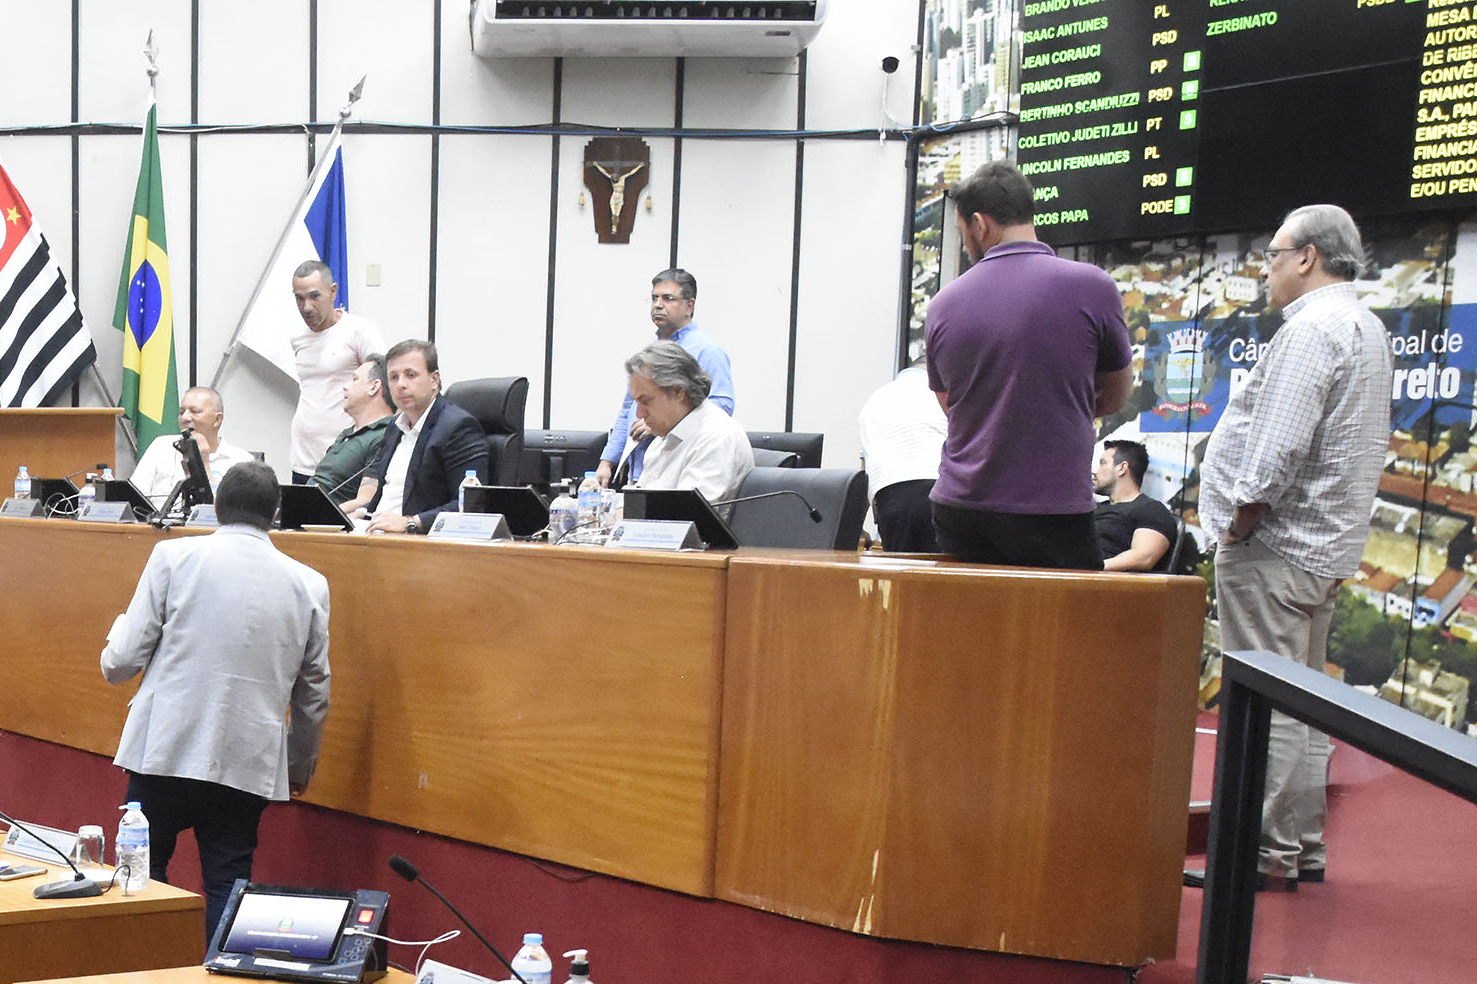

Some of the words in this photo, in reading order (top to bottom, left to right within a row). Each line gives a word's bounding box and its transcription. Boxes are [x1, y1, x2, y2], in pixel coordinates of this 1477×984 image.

[1024, 27, 1055, 44] ISAAC
[1056, 16, 1109, 38] ANTUNES
[1154, 5, 1170, 19] PL
[1206, 11, 1278, 37] ZERBINATO
[1426, 6, 1470, 28] MESA
[1022, 53, 1050, 70] JEAN
[1051, 44, 1102, 65] CORAUCI
[1152, 30, 1178, 47] PSD
[1422, 49, 1444, 67] DE
[1020, 77, 1064, 96] FRANCO
[1064, 70, 1102, 89] FERRO
[1150, 59, 1169, 75] PP
[1019, 102, 1074, 123] BERTINHO
[1075, 92, 1141, 115] SCANDIUZZI
[1148, 86, 1174, 103] PSD
[1417, 105, 1451, 124] S.A.,
[1018, 131, 1071, 150] COLETIVO
[1071, 124, 1111, 142] JUDETI
[1111, 120, 1139, 136] ZILLI
[1145, 116, 1163, 132] PT
[1063, 150, 1131, 171] FERNANDES
[1144, 146, 1161, 160] PL
[1142, 173, 1168, 188] PSD
[1410, 180, 1446, 198] E/OU
[1061, 209, 1089, 223] PAPA
[1140, 199, 1174, 215] PODE
[1431, 328, 1463, 353] de
